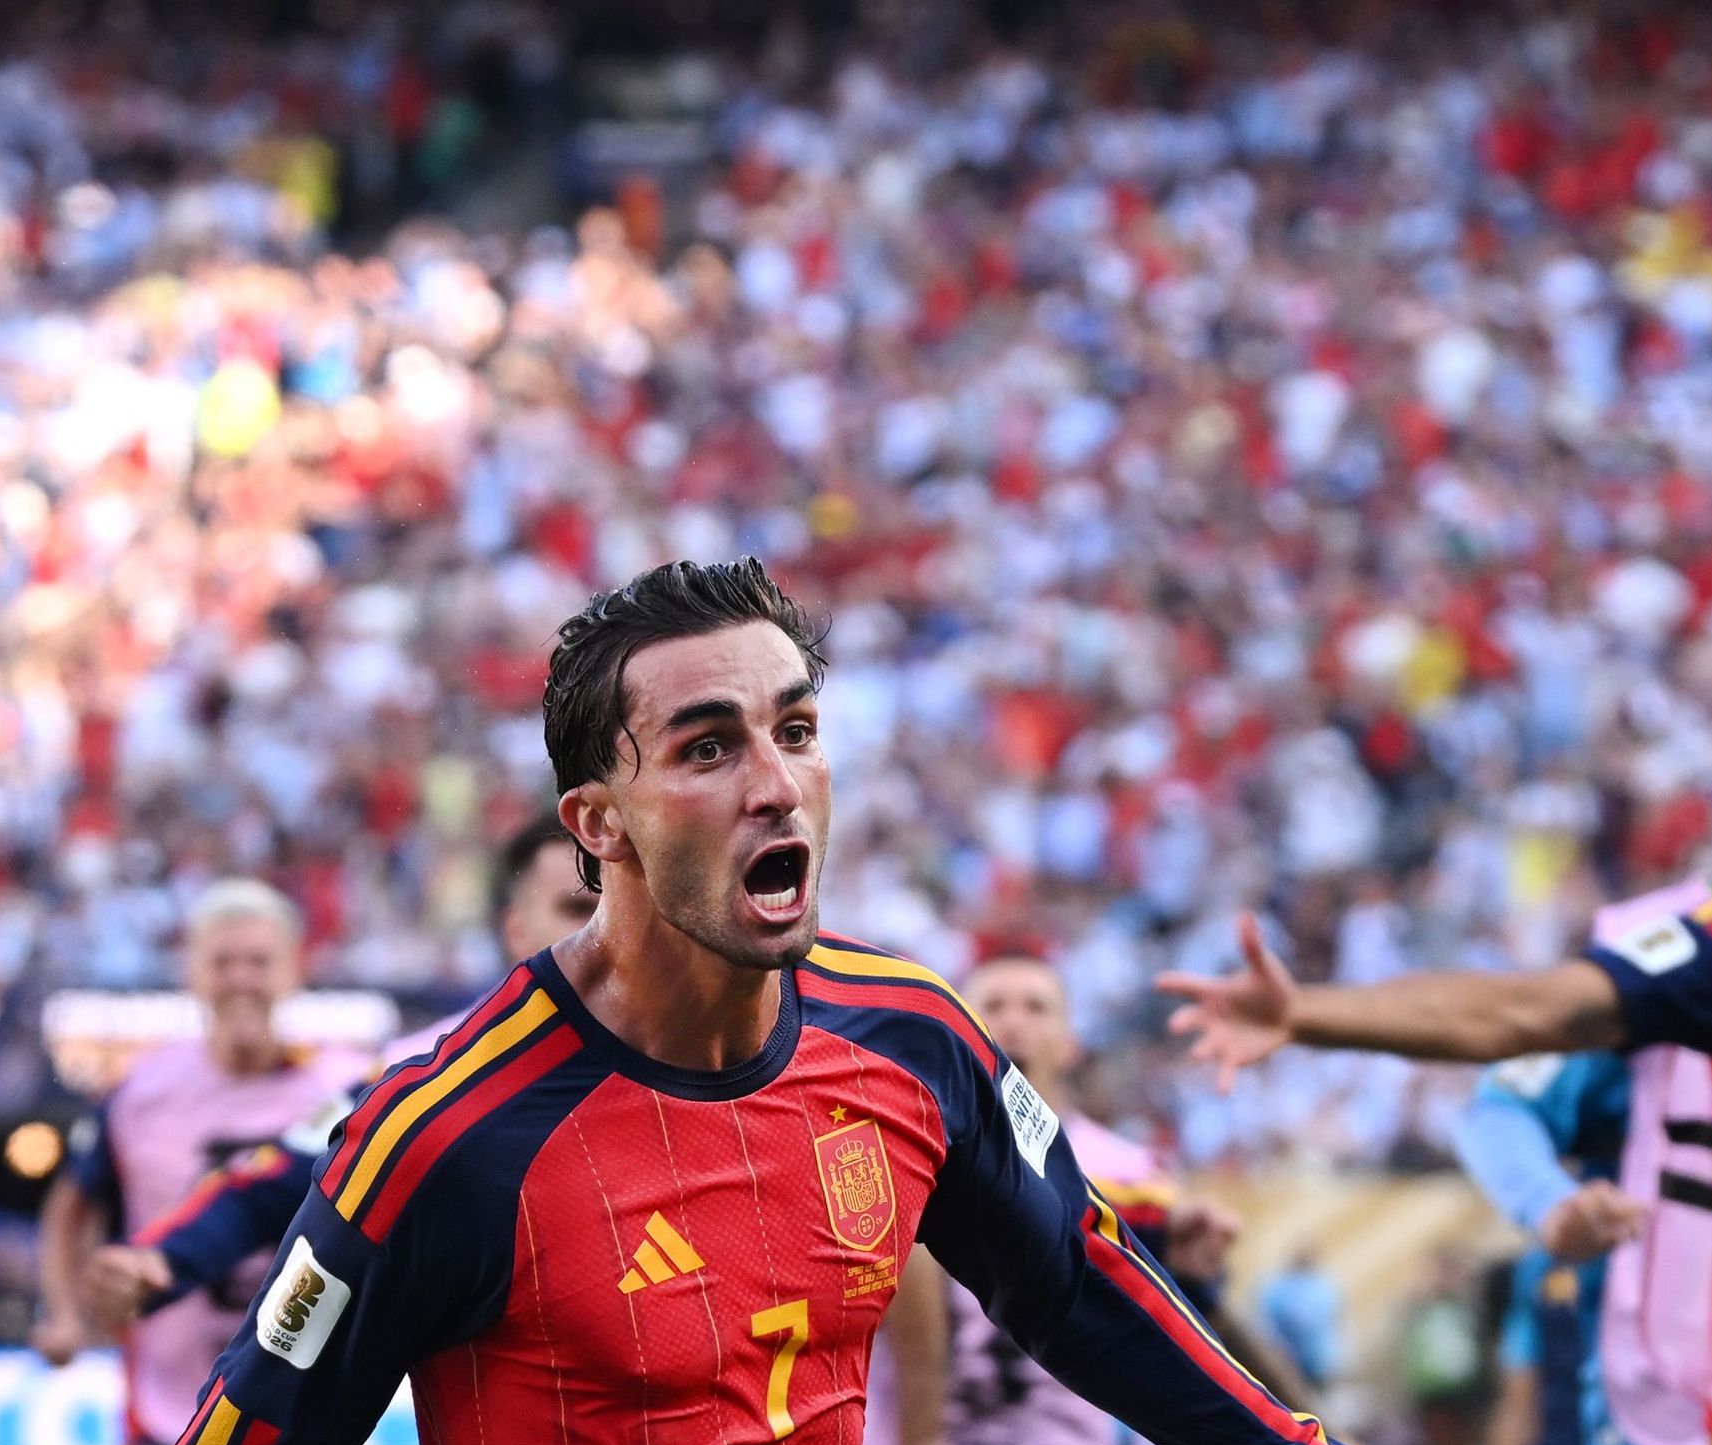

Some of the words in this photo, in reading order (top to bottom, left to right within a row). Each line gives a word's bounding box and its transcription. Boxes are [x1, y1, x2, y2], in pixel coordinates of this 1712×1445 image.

[264, 1328, 294, 1352] 026
[281, 1330, 298, 1343] CUP
[751, 1298, 808, 1441] 7
